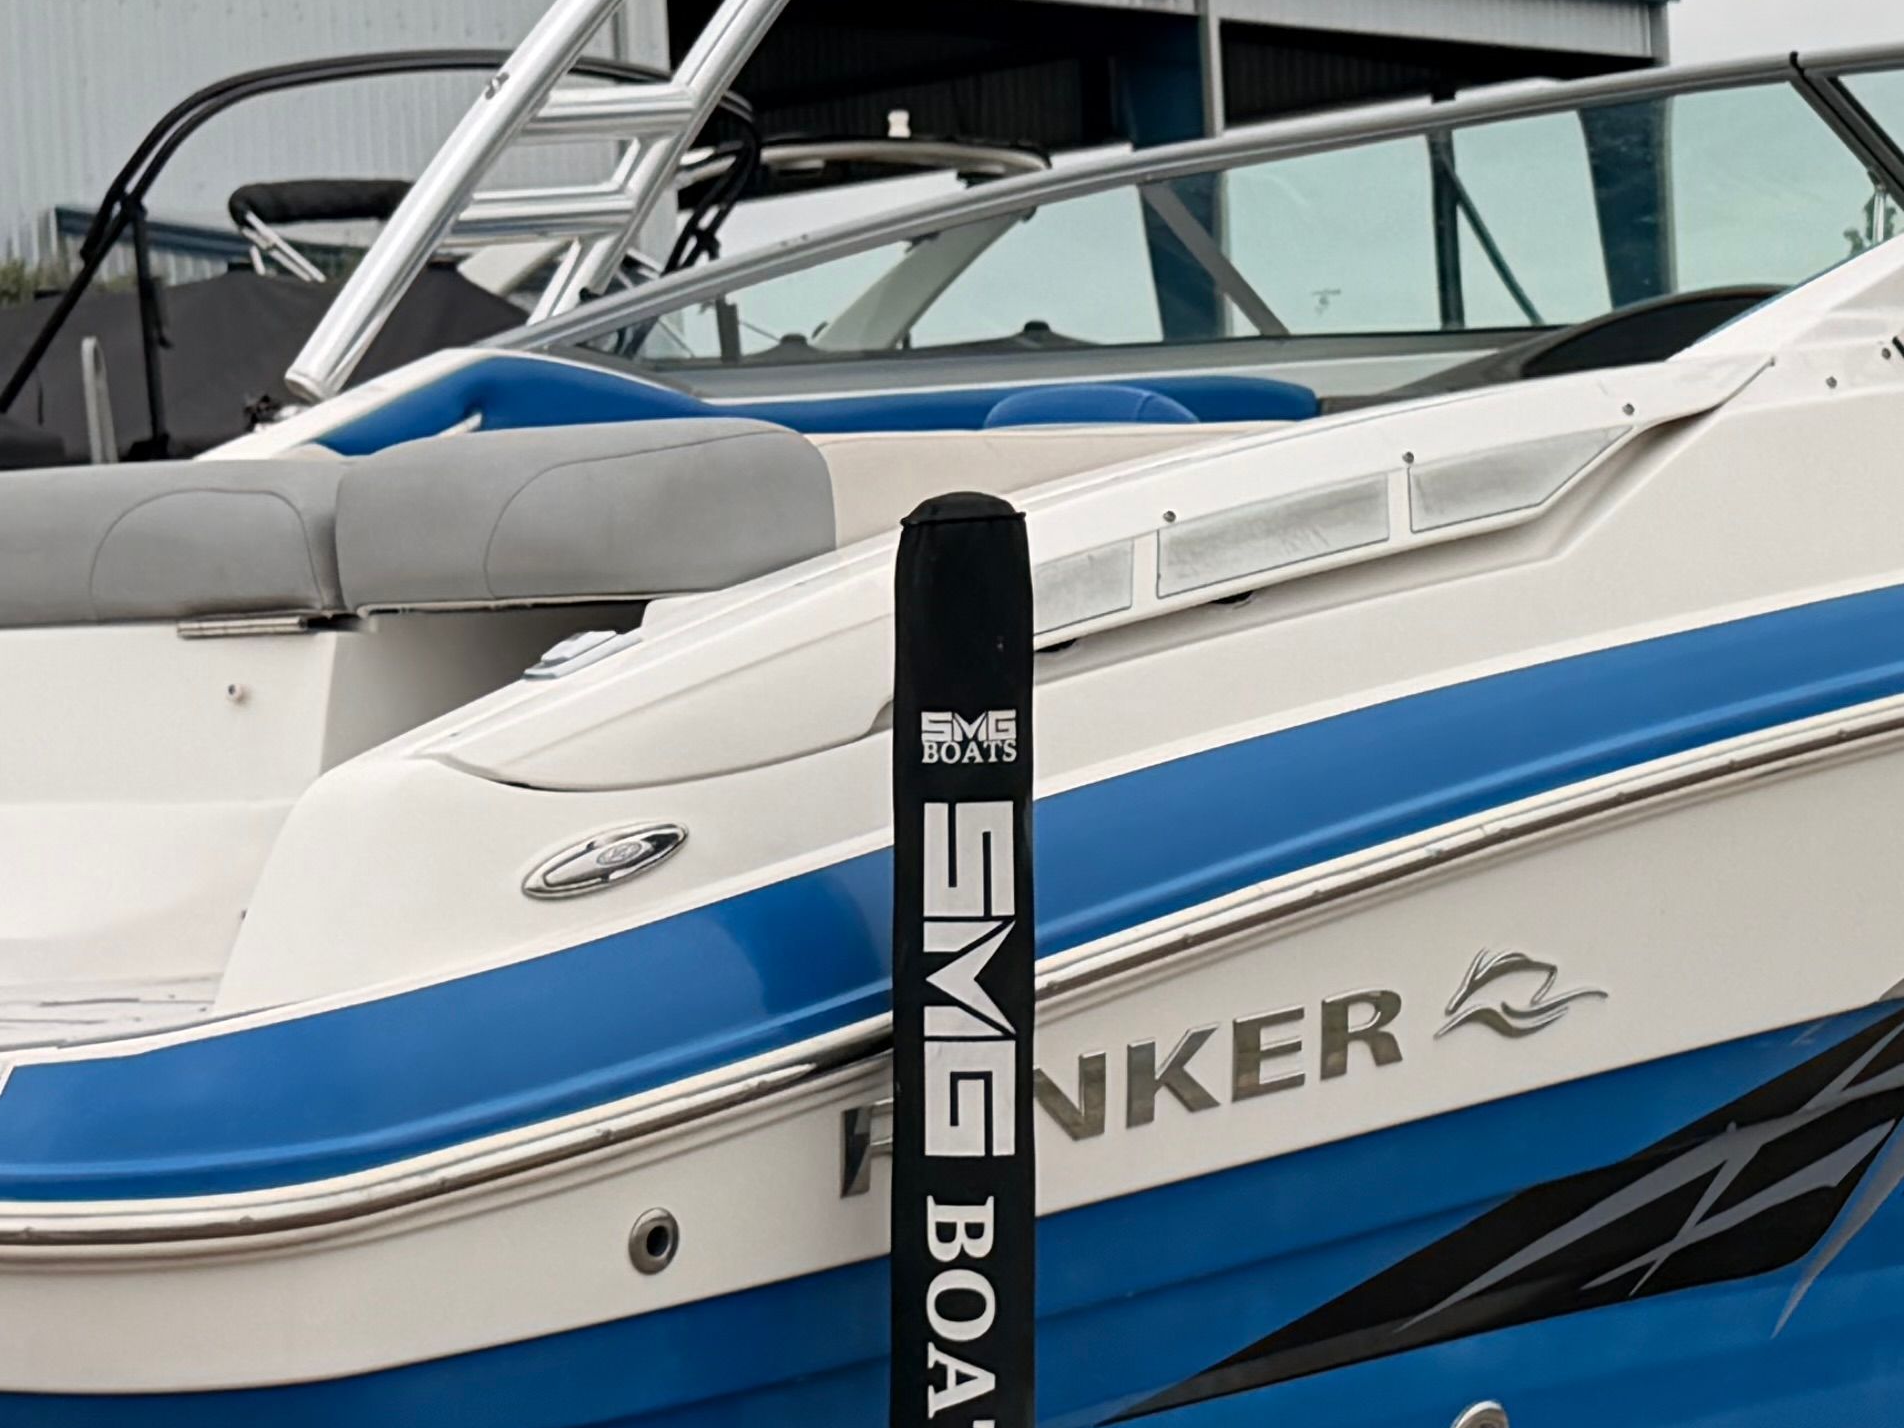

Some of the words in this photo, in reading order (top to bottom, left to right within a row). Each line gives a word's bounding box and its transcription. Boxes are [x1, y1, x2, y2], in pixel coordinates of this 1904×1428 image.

[921, 709, 1017, 743] SMG
[921, 740, 1017, 764] BOATS
[923, 801, 1016, 1156] SMG
